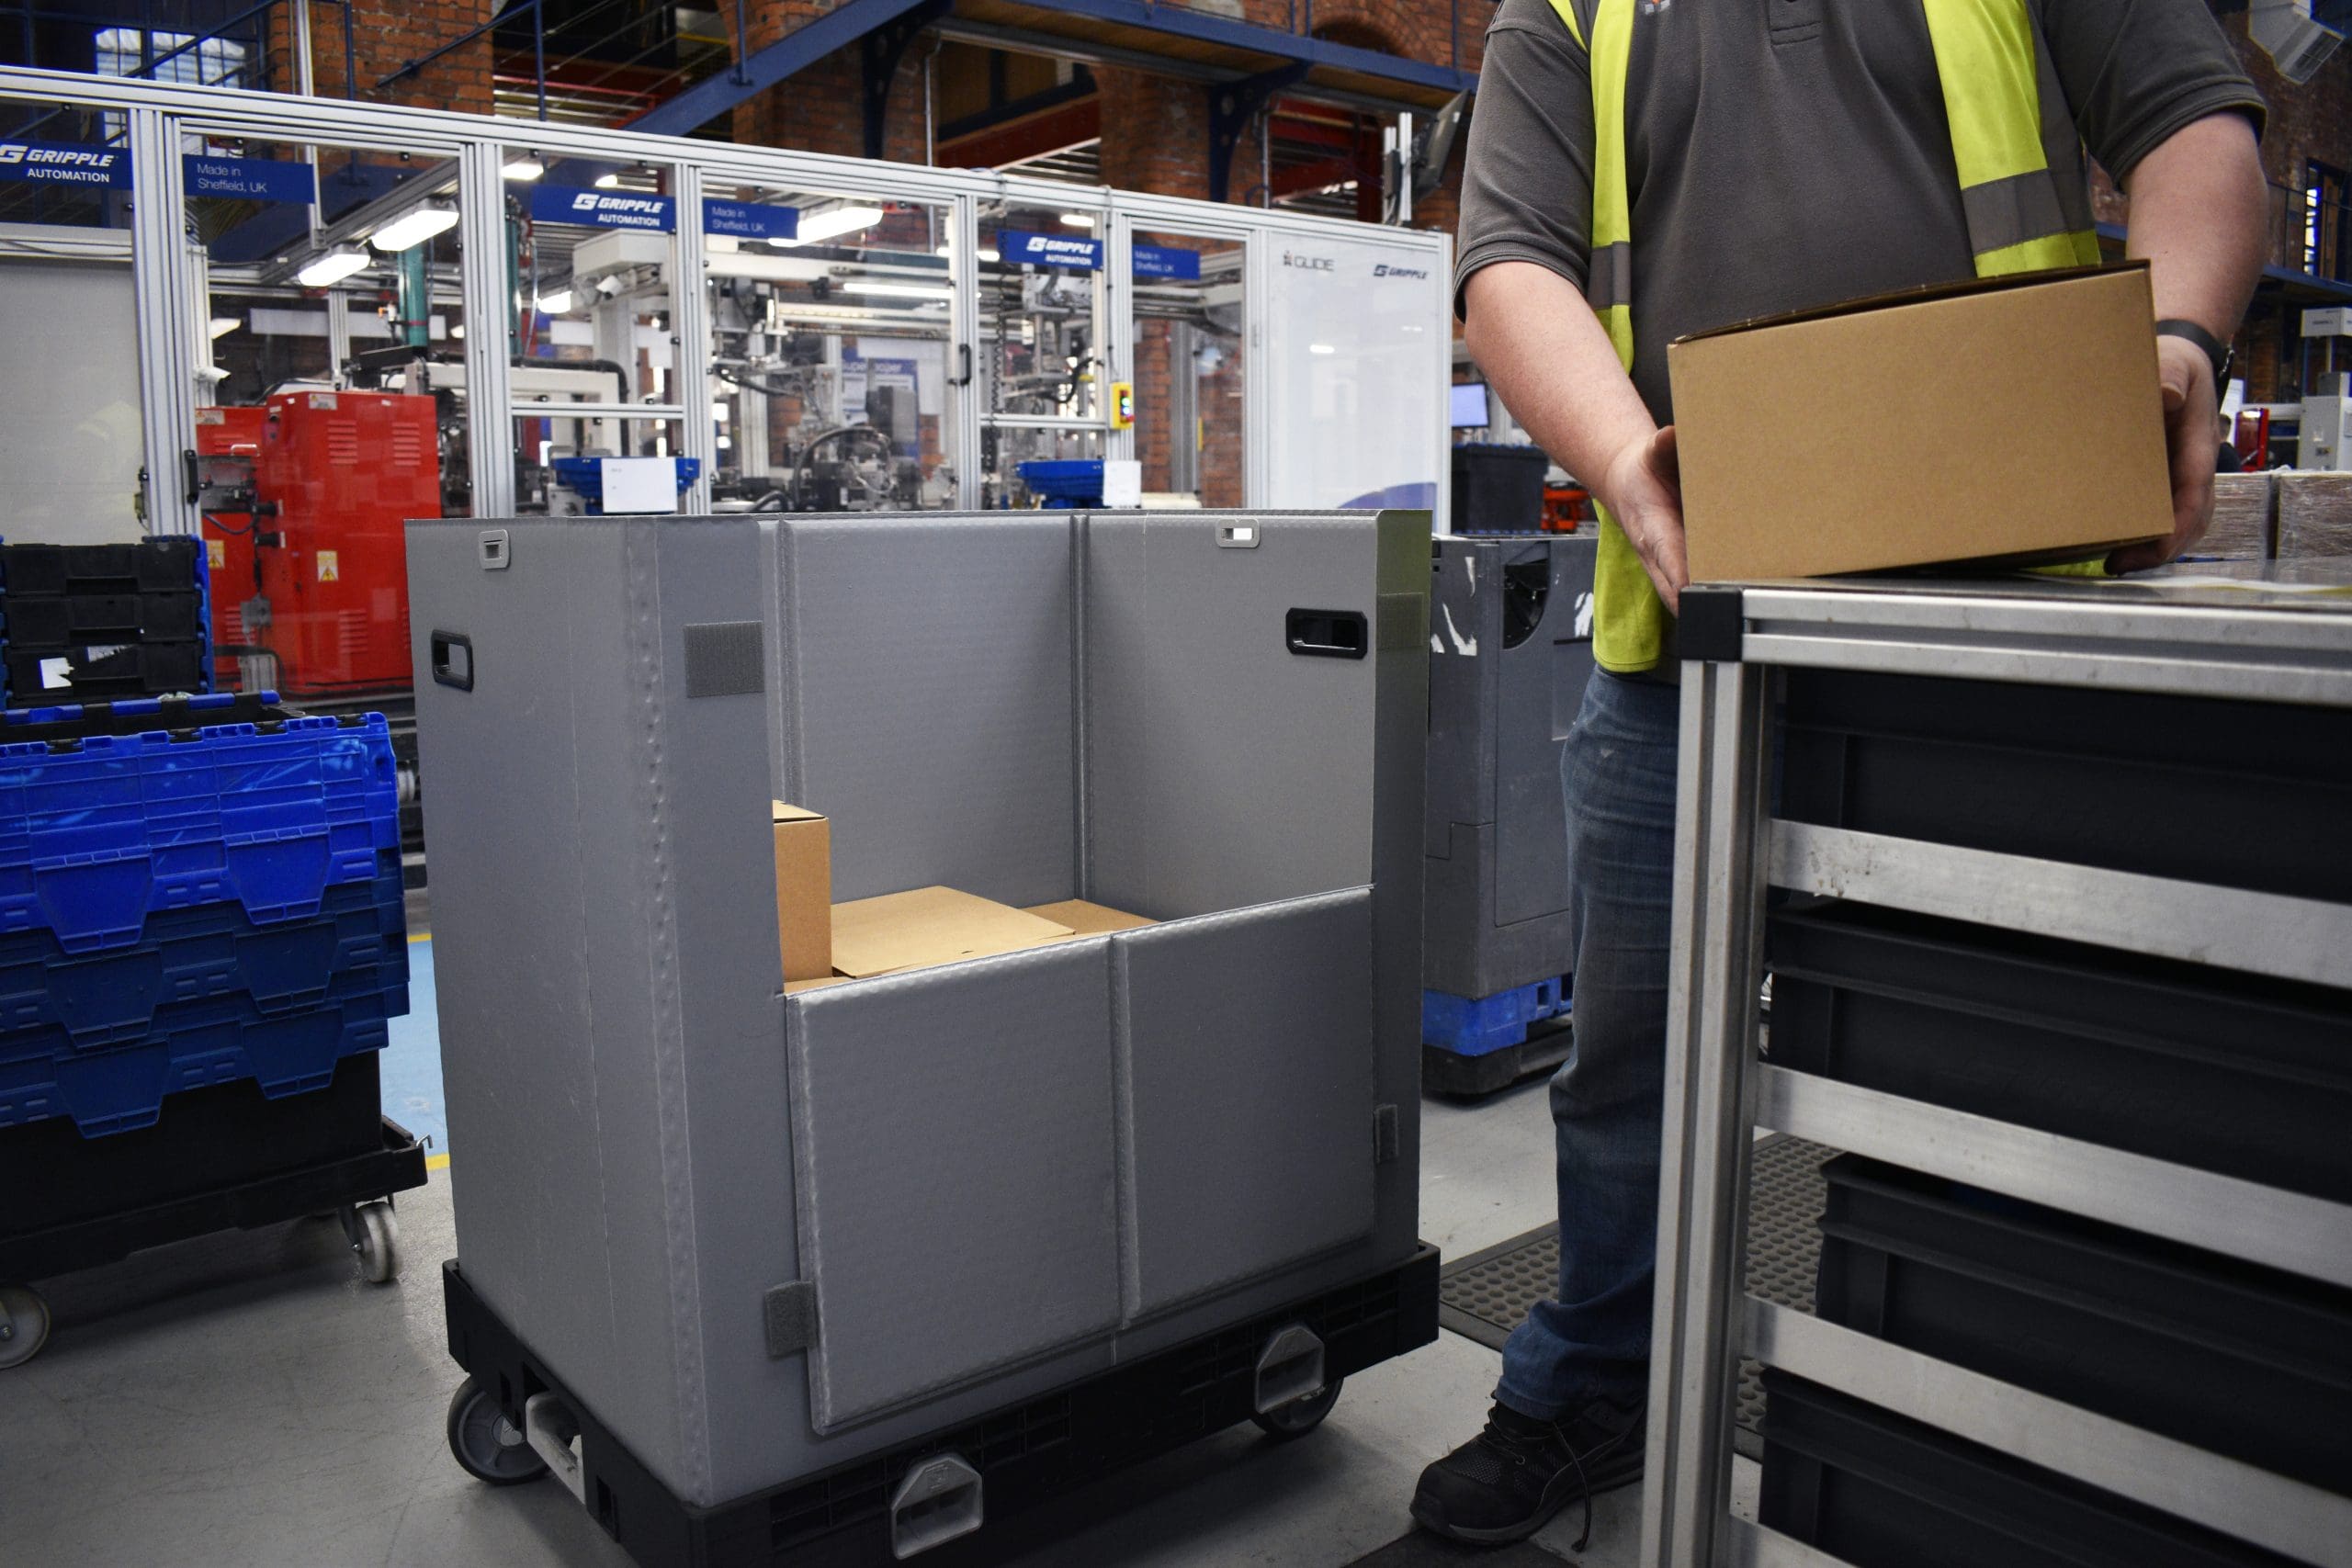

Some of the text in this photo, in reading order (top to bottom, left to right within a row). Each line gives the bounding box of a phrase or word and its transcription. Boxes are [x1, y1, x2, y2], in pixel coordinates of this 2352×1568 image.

[26, 149, 115, 167] GRIPPLE
[28, 168, 110, 183] AUTOMATION
[197, 164, 242, 176] Made in
[198, 177, 267, 193] Sheffield, UK
[596, 197, 664, 213] GRIPPLE
[597, 213, 661, 227] AUTOMATION
[1046, 240, 1094, 254] GRIPPLE
